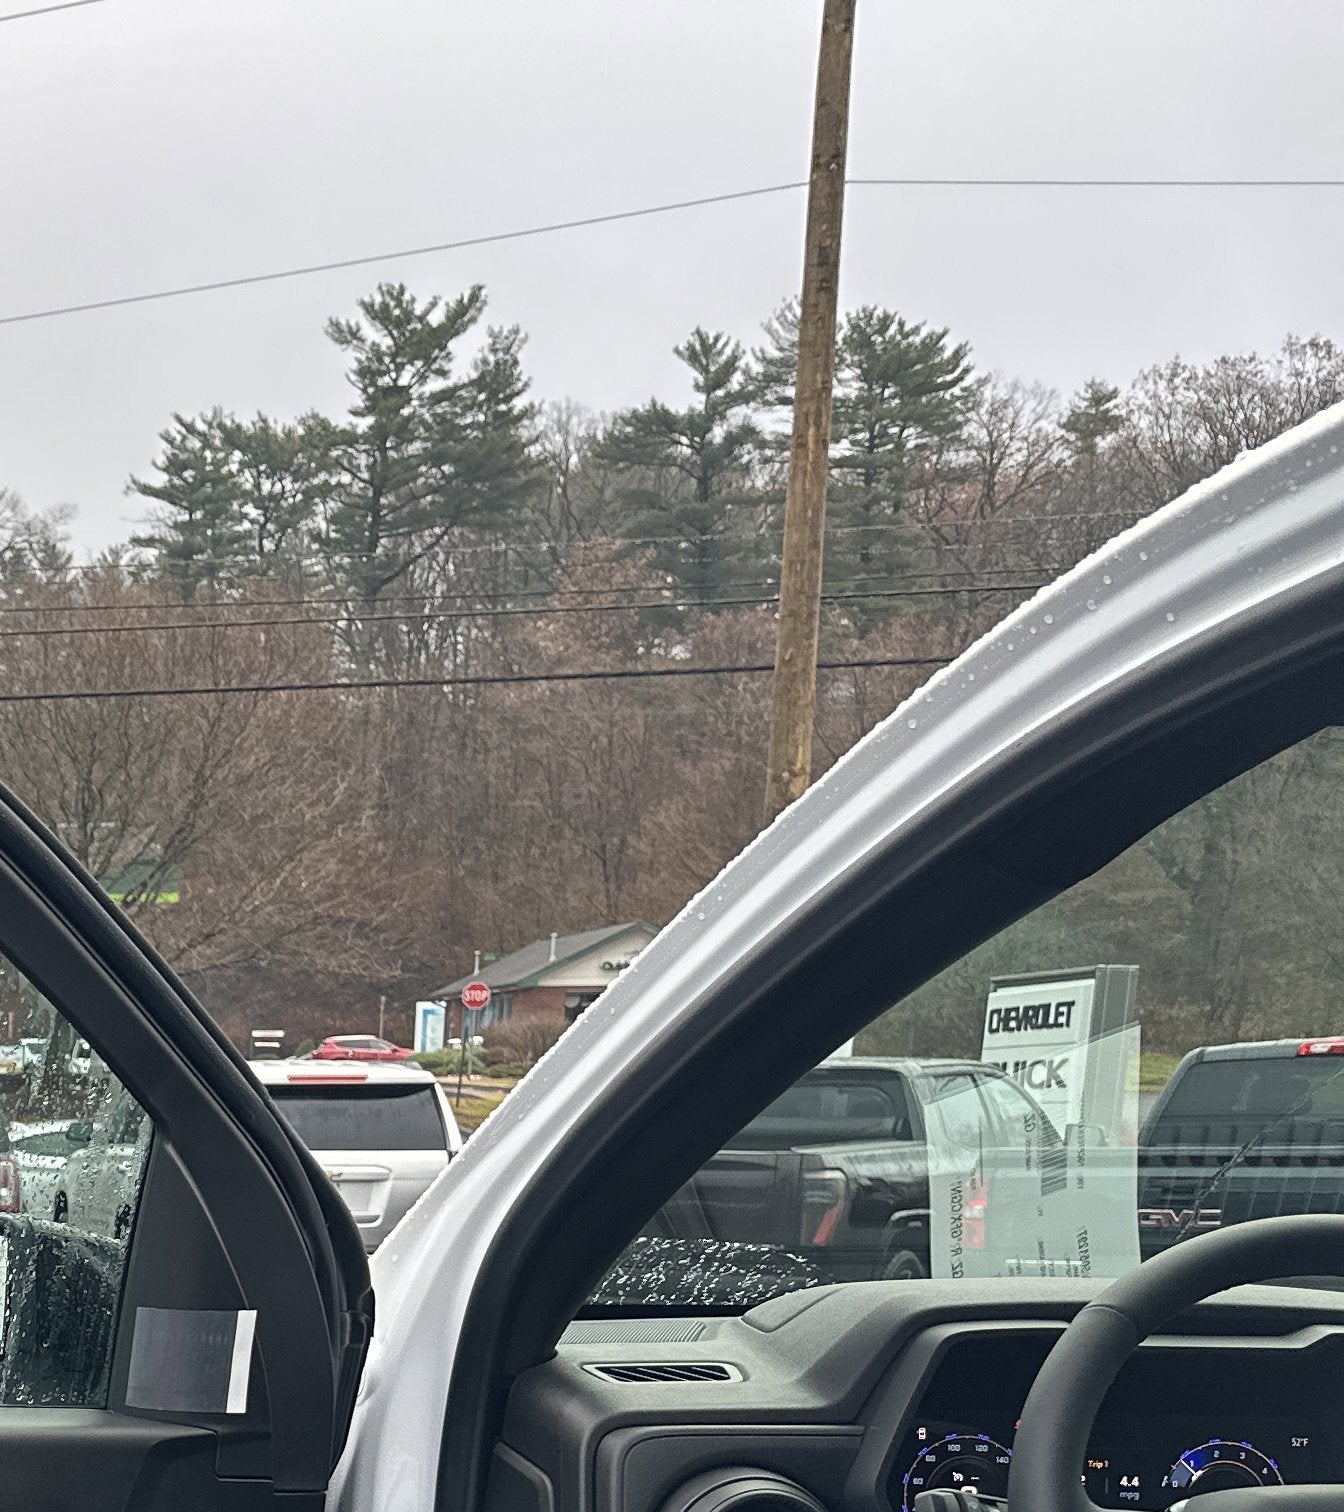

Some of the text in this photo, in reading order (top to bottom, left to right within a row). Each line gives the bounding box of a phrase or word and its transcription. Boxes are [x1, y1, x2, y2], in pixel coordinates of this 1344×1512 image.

[464, 989, 489, 1002] STOP
[988, 1000, 1075, 1034] CHEVROLET
[1138, 1207, 1222, 1230] GMC
[975, 1444, 989, 1452] 120
[1088, 1460, 1103, 1469] Trip
[1119, 1475, 1140, 1487] 4.4
[1119, 1491, 1140, 1501] mpg
